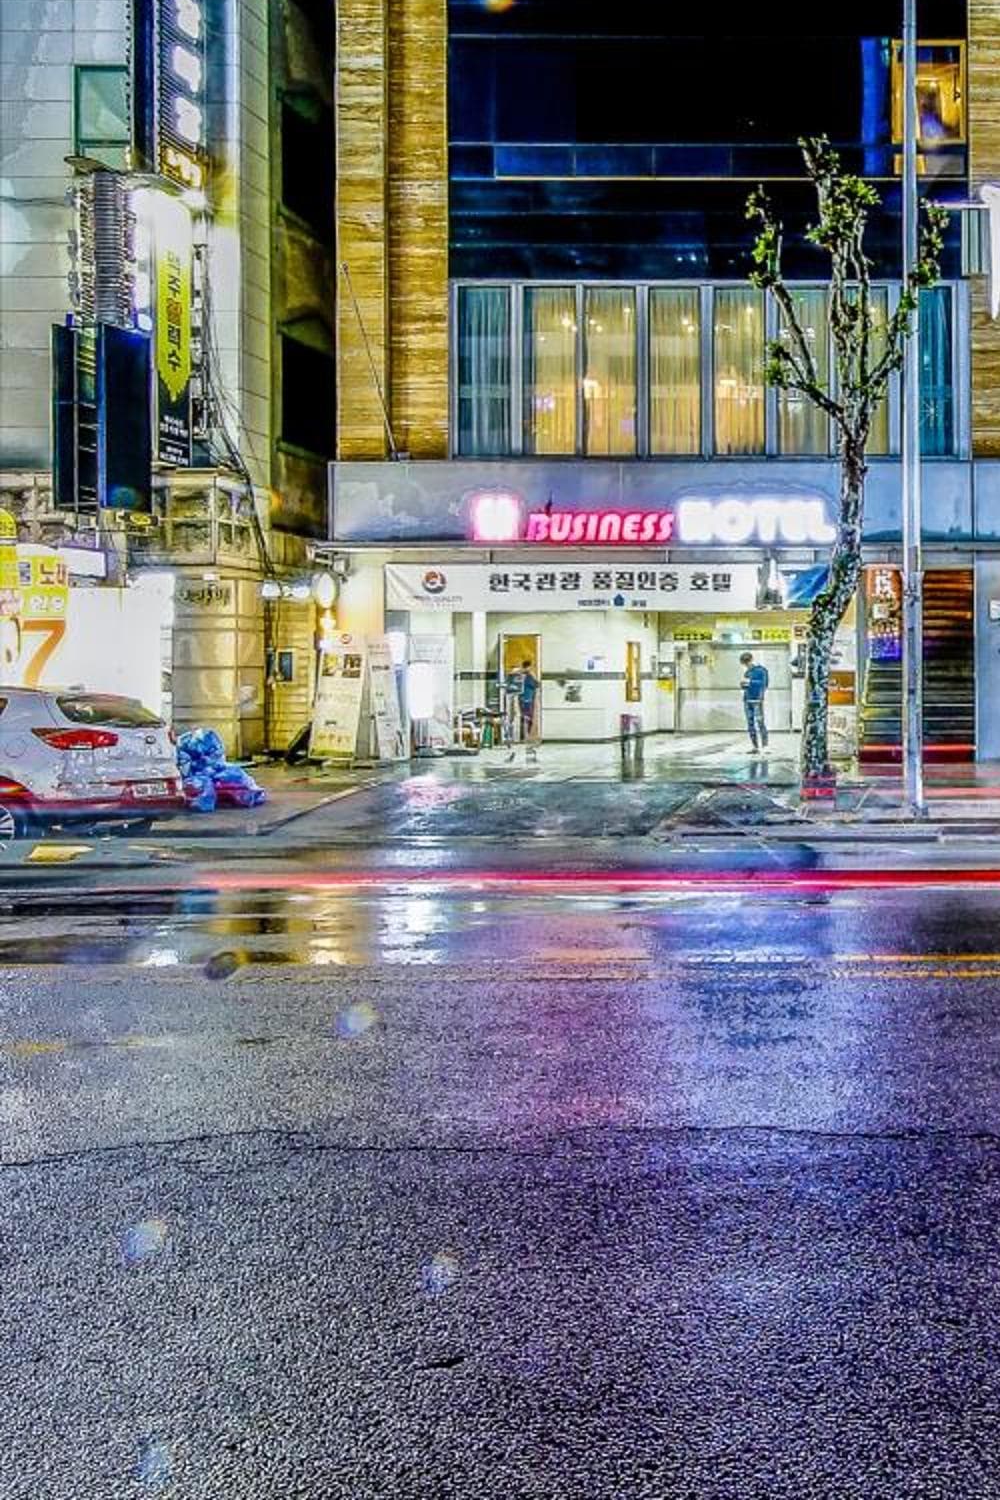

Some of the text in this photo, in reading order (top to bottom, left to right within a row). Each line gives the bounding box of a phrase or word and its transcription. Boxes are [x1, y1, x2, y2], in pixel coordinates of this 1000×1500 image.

[525, 512, 675, 542] BUSINESS
[678, 499, 838, 543] HOTEL
[489, 570, 732, 593] 한국관광 품질인증 호텔
